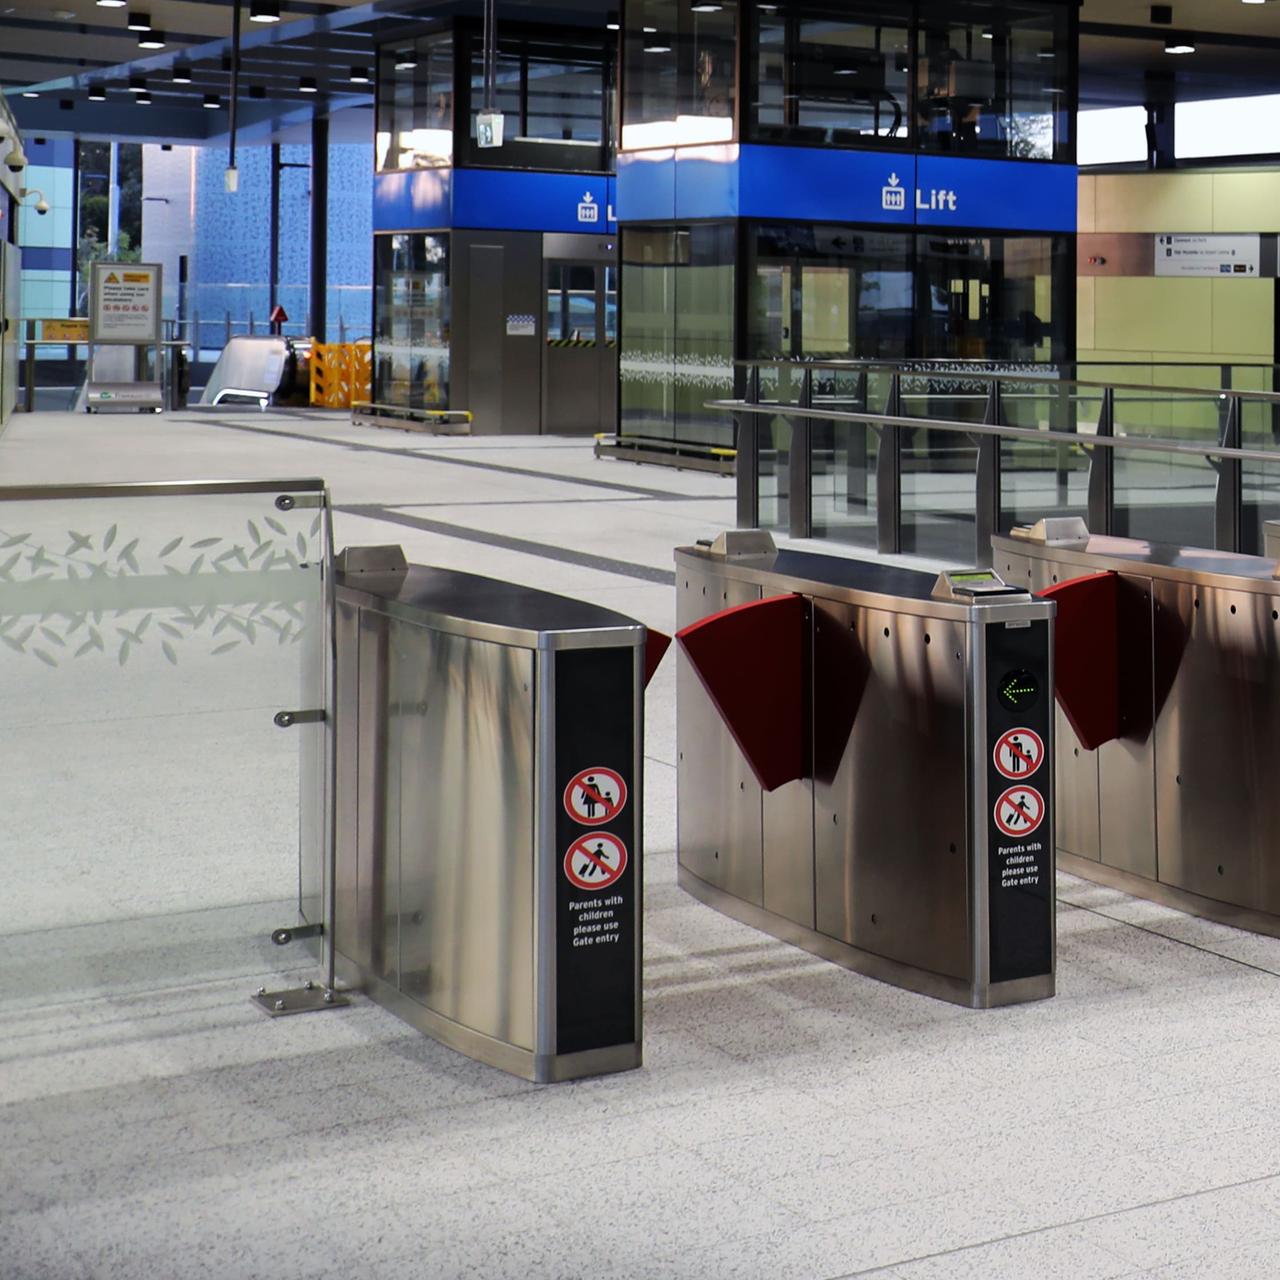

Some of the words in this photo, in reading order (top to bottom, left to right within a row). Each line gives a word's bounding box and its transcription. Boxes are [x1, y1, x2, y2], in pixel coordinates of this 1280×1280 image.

[916, 189, 957, 210] Lift
[998, 844, 1025, 855] Parents
[1026, 842, 1042, 850] with
[1006, 856, 1034, 865] children
[1002, 868, 1024, 878] please
[1002, 878, 1018, 888] Gate
[1020, 876, 1039, 885] entry
[568, 898, 602, 911] Parents
[604, 896, 623, 906] with
[578, 910, 614, 922] children
[573, 924, 602, 936] please
[604, 922, 619, 930] use
[572, 936, 594, 947] Gate
[595, 933, 620, 944] entry
